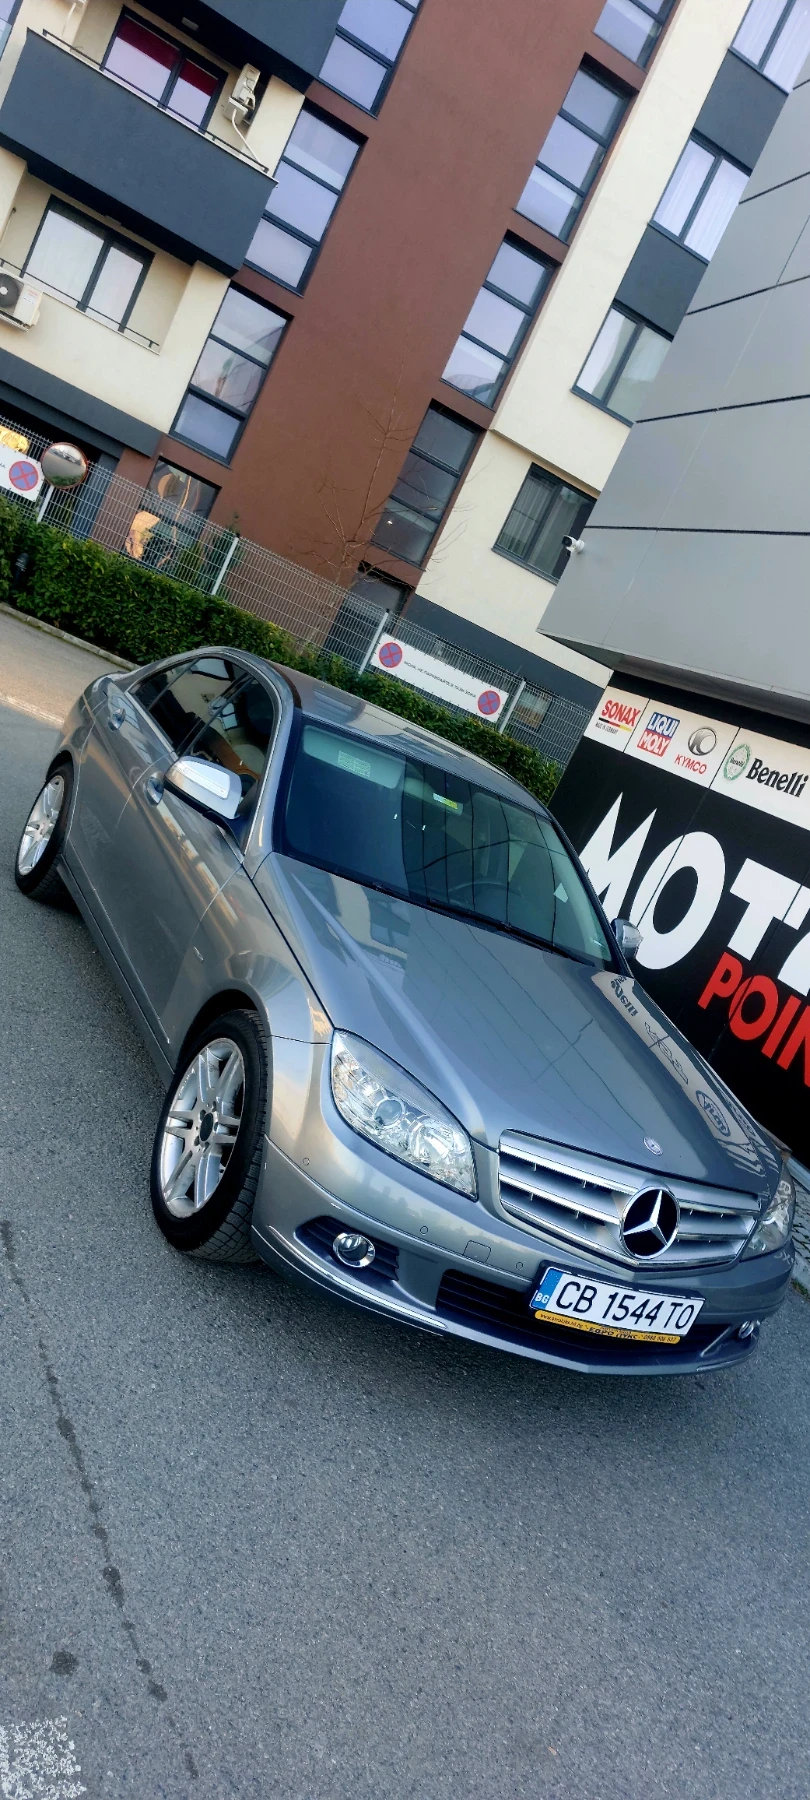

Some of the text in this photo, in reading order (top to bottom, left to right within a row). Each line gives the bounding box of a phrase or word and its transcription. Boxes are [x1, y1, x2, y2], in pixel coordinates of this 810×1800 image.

[601, 700, 641, 727] SONAX
[649, 714, 680, 737] LIQUI
[638, 731, 670, 756] MOLY
[674, 754, 707, 774] KYMCO
[745, 757, 809, 798] Benelli
[578, 791, 810, 997] MOT
[535, 1292, 550, 1304] BG
[555, 1281, 695, 1330] CB 1544 TO
